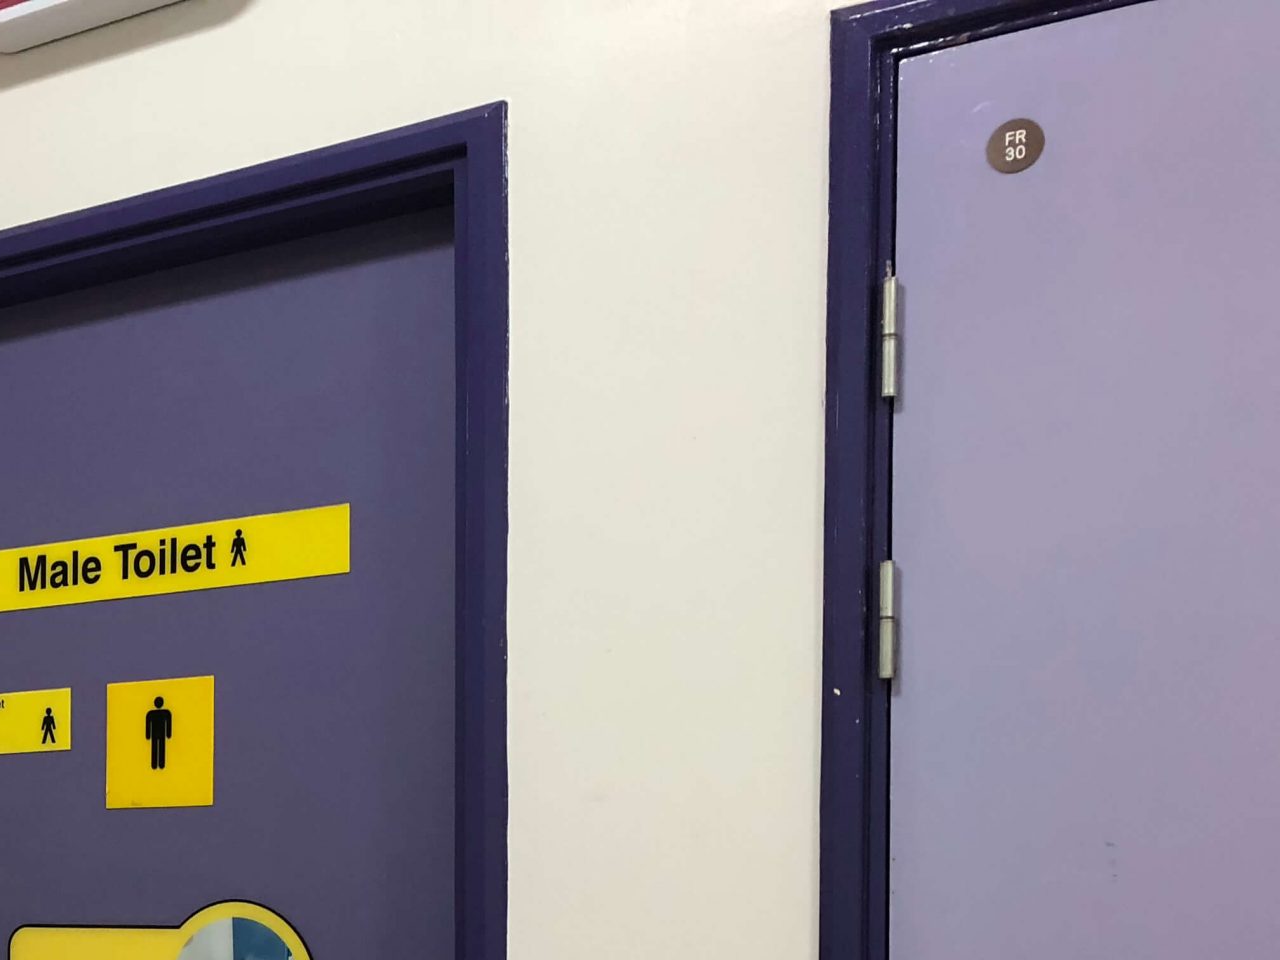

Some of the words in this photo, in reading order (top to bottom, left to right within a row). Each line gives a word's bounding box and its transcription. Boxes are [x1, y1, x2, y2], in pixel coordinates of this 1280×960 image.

[1005, 129, 1027, 146] FR
[1005, 144, 1026, 161] 30
[18, 550, 102, 593] Male
[113, 534, 217, 580] Toilet
